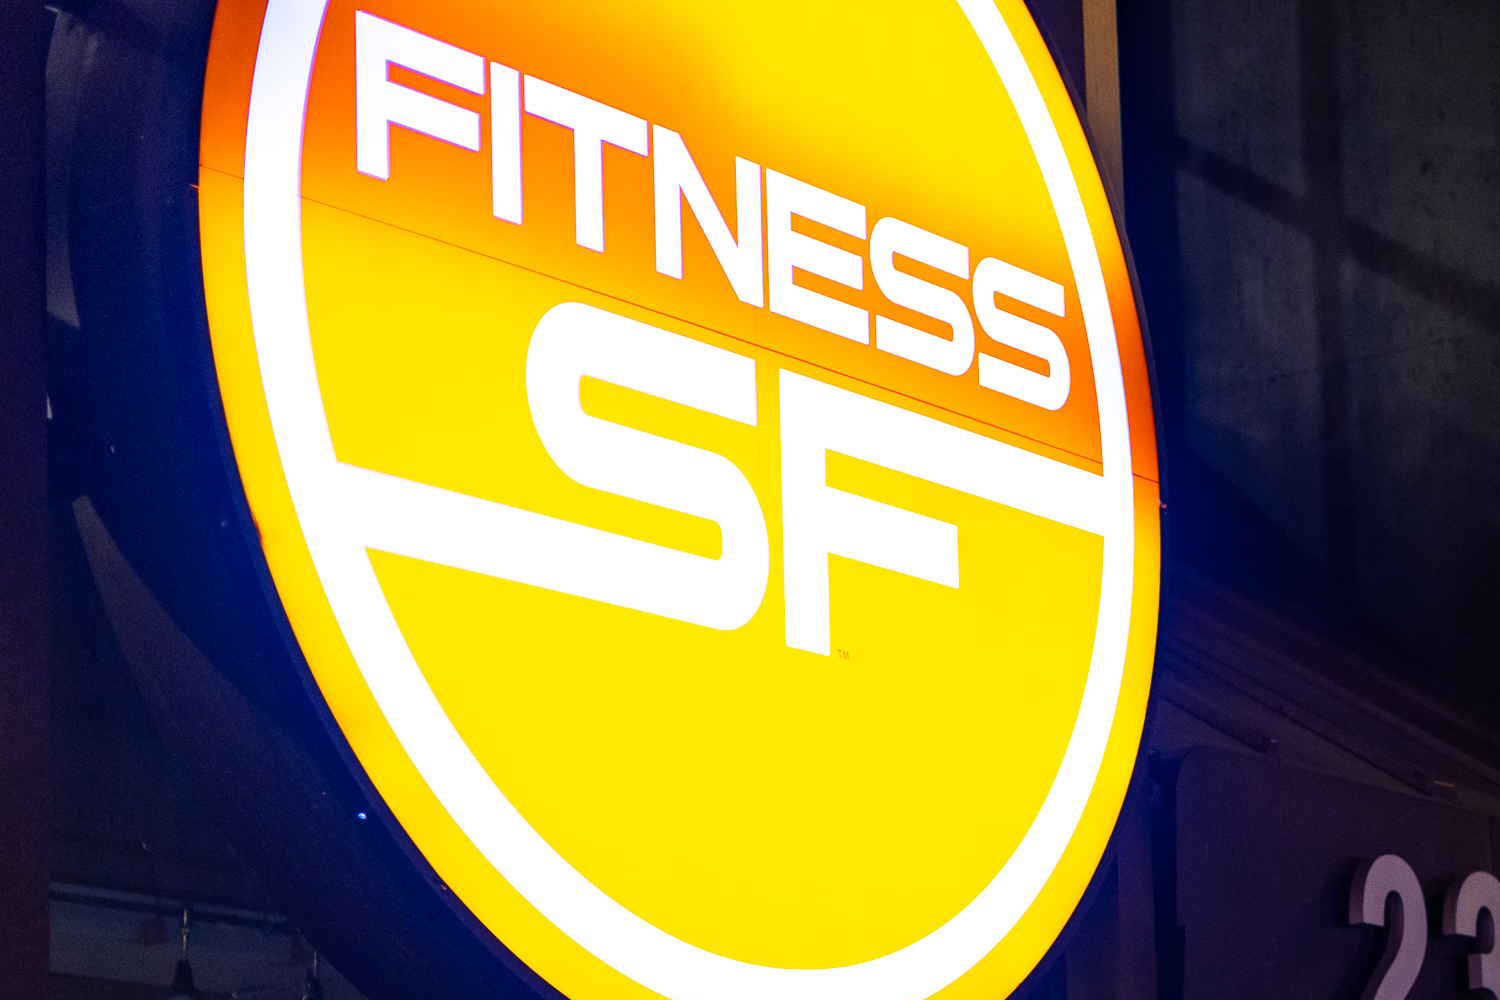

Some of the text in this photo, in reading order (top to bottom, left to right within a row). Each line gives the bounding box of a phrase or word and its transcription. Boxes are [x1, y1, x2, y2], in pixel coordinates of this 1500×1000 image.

[355, 10, 1071, 411] FITNESS
[526, 301, 960, 656] SF
[837, 649, 849, 661] TM
